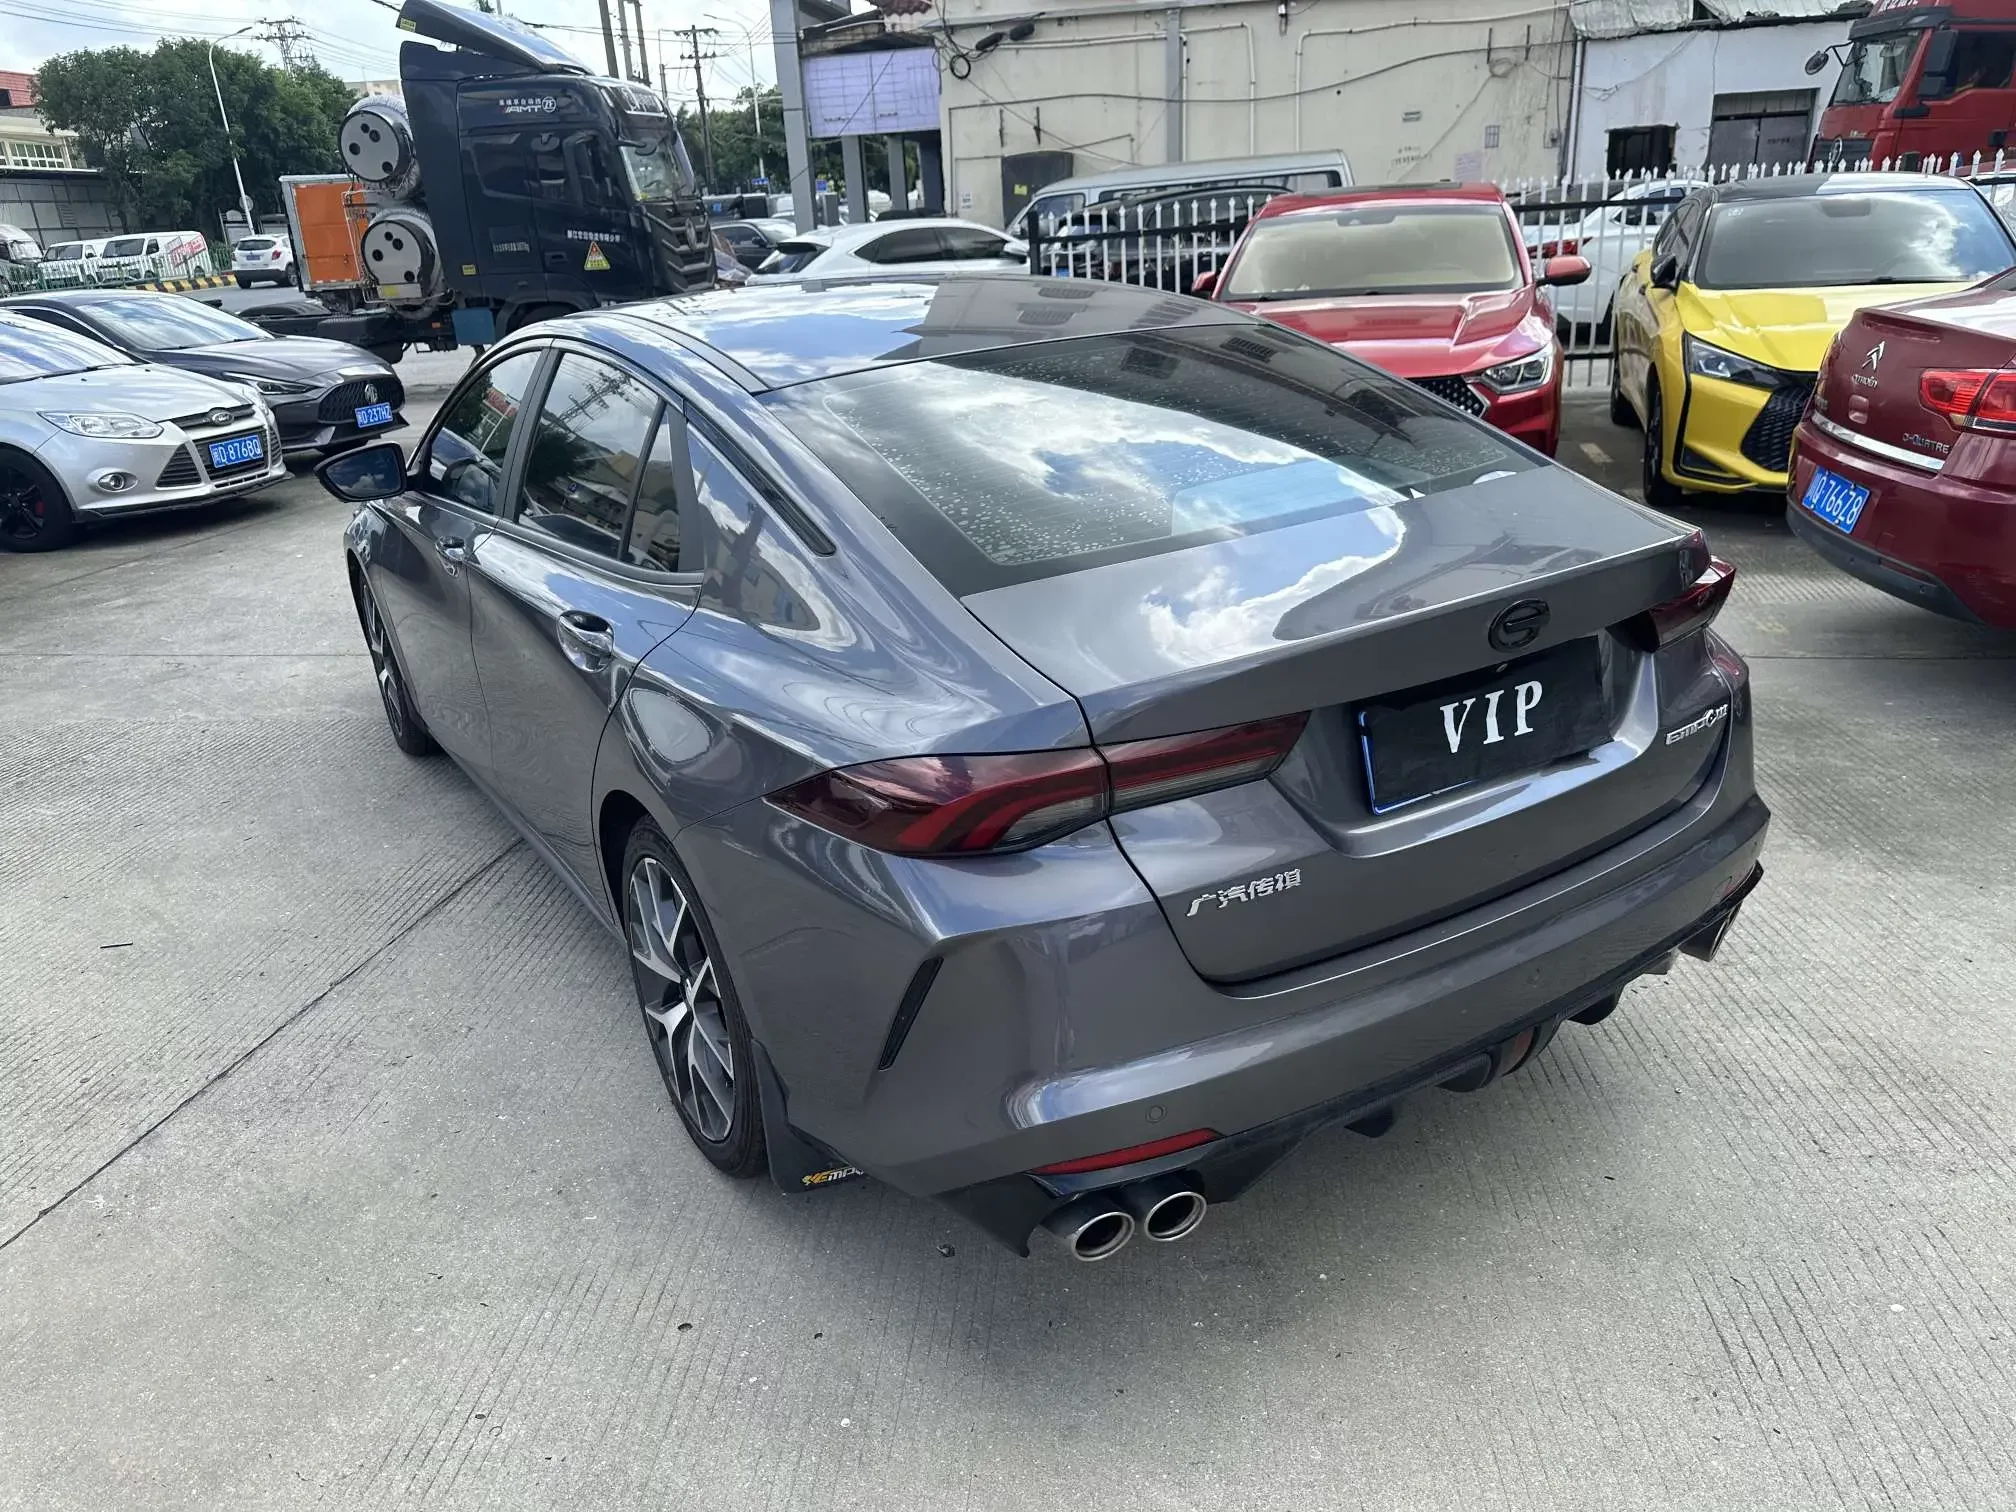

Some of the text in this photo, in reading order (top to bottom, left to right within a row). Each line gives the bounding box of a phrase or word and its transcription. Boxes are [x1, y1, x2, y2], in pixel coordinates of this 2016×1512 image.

[1440, 680, 1543, 754] VIP
[1187, 868, 1301, 916] 广汽传祺
